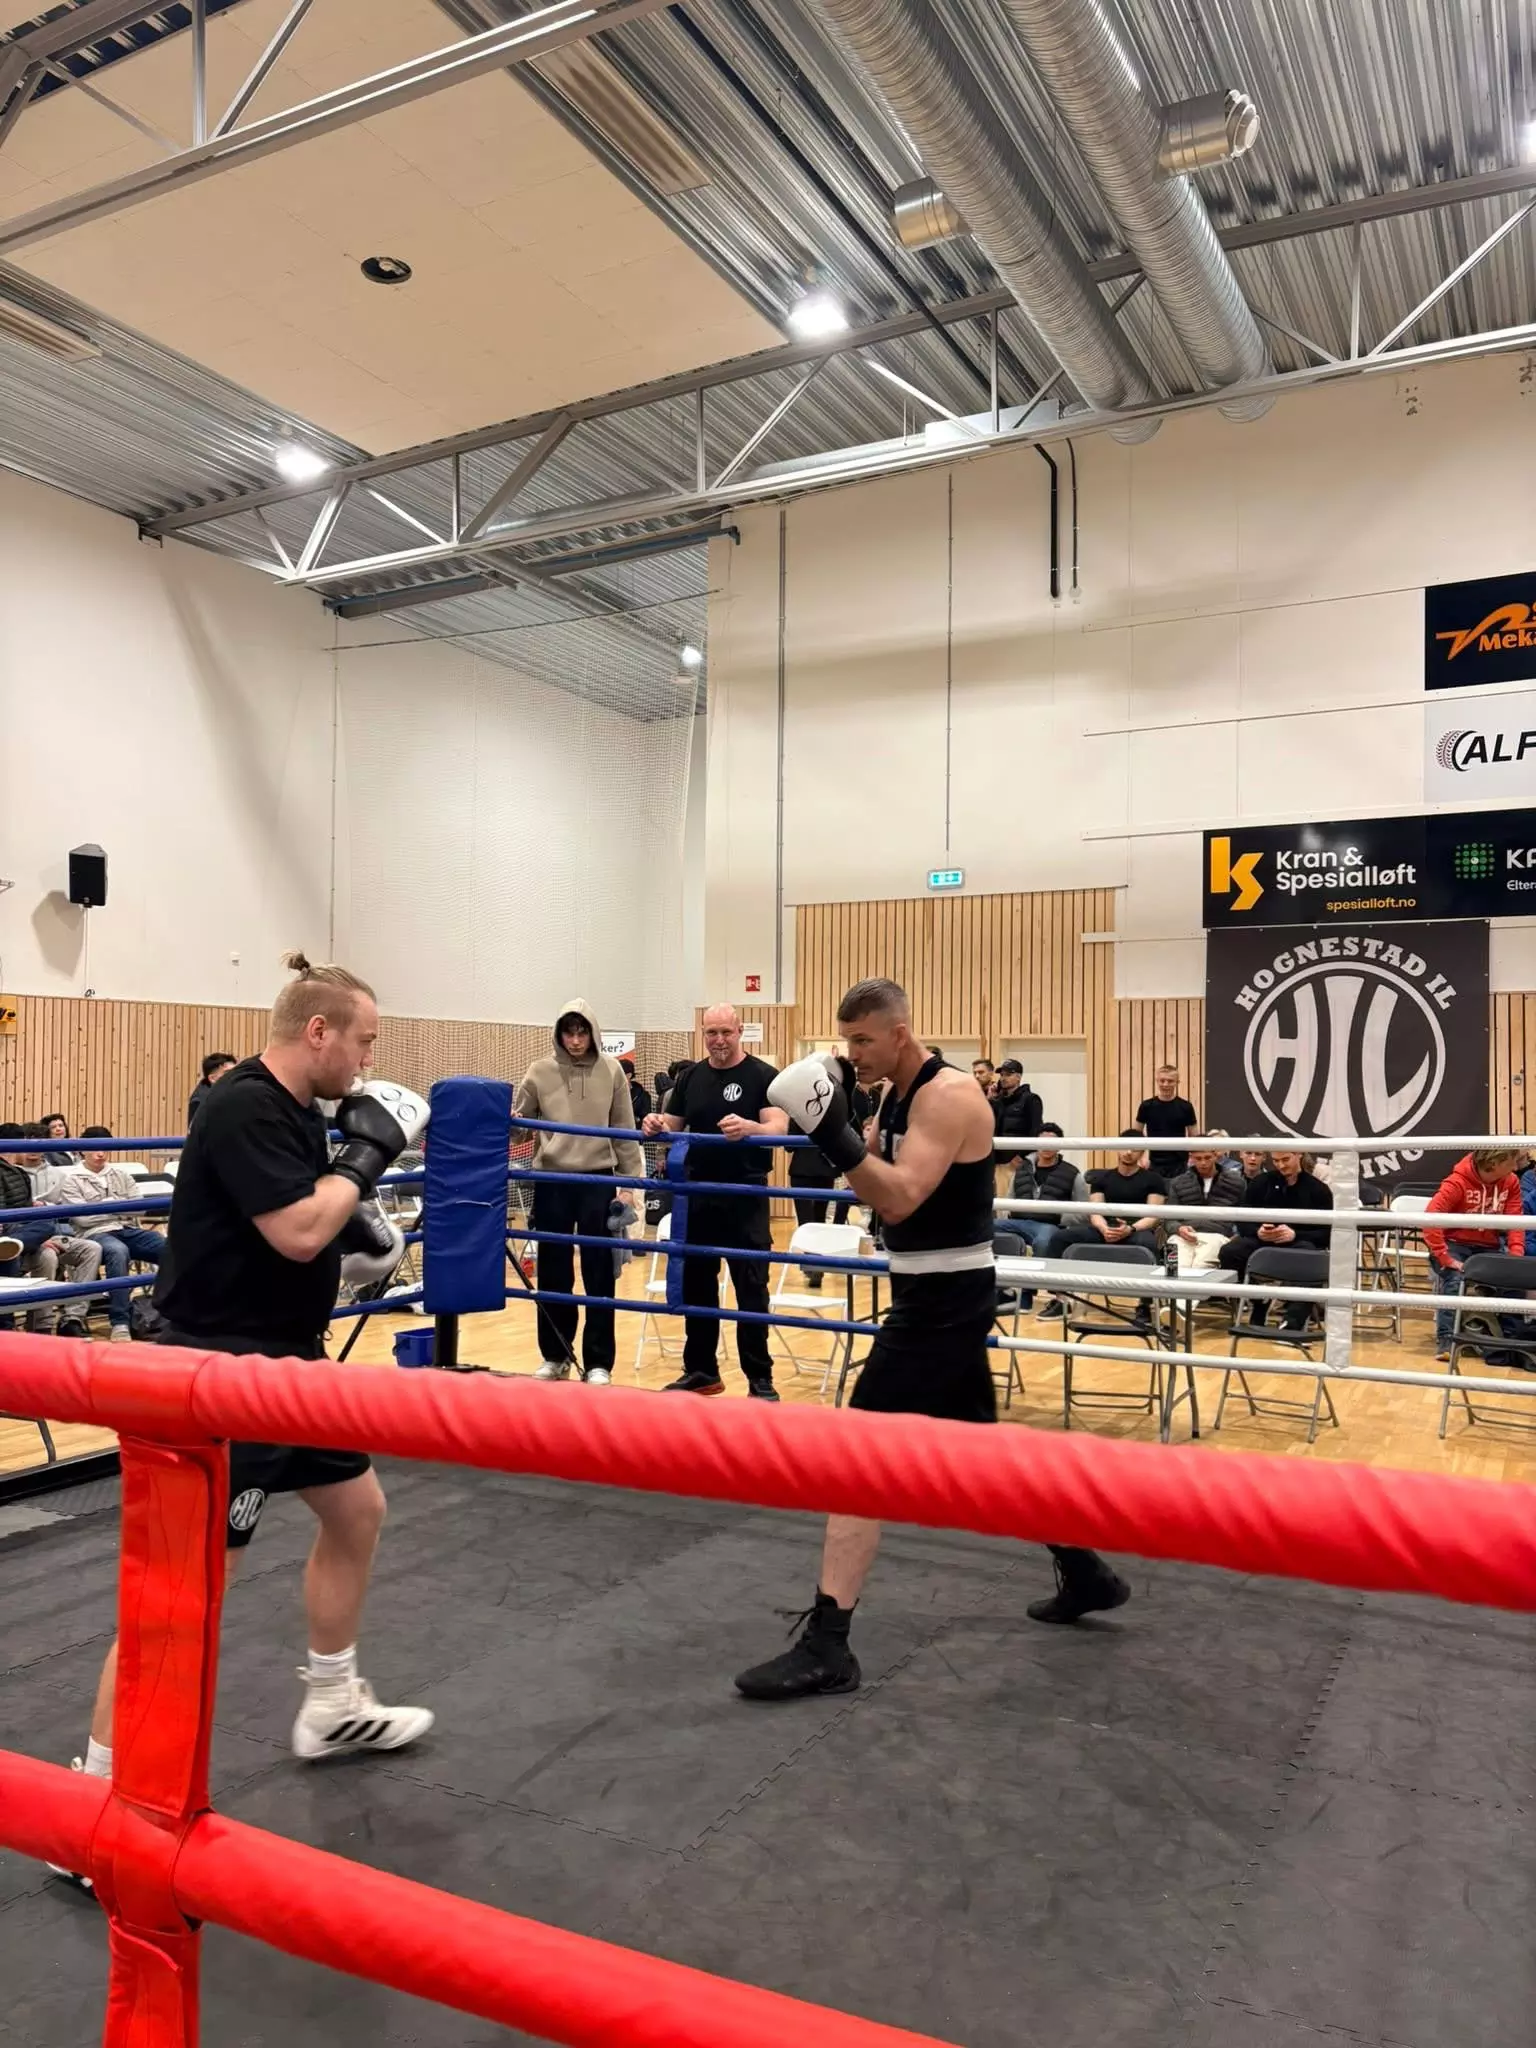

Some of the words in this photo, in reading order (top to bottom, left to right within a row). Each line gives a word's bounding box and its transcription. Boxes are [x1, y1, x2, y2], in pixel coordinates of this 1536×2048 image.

[1479, 629, 1536, 652] Mek
[1276, 851, 1337, 870] Kran
[1343, 847, 1364, 866] &
[1276, 863, 1416, 896] Spesialløft
[1506, 880, 1536, 891] Elter
[1326, 897, 1416, 913] spesialloft.no
[1234, 936, 1427, 1012] HOGNESTAD
[1424, 973, 1457, 1011] IL
[1259, 975, 1430, 1138] HIL
